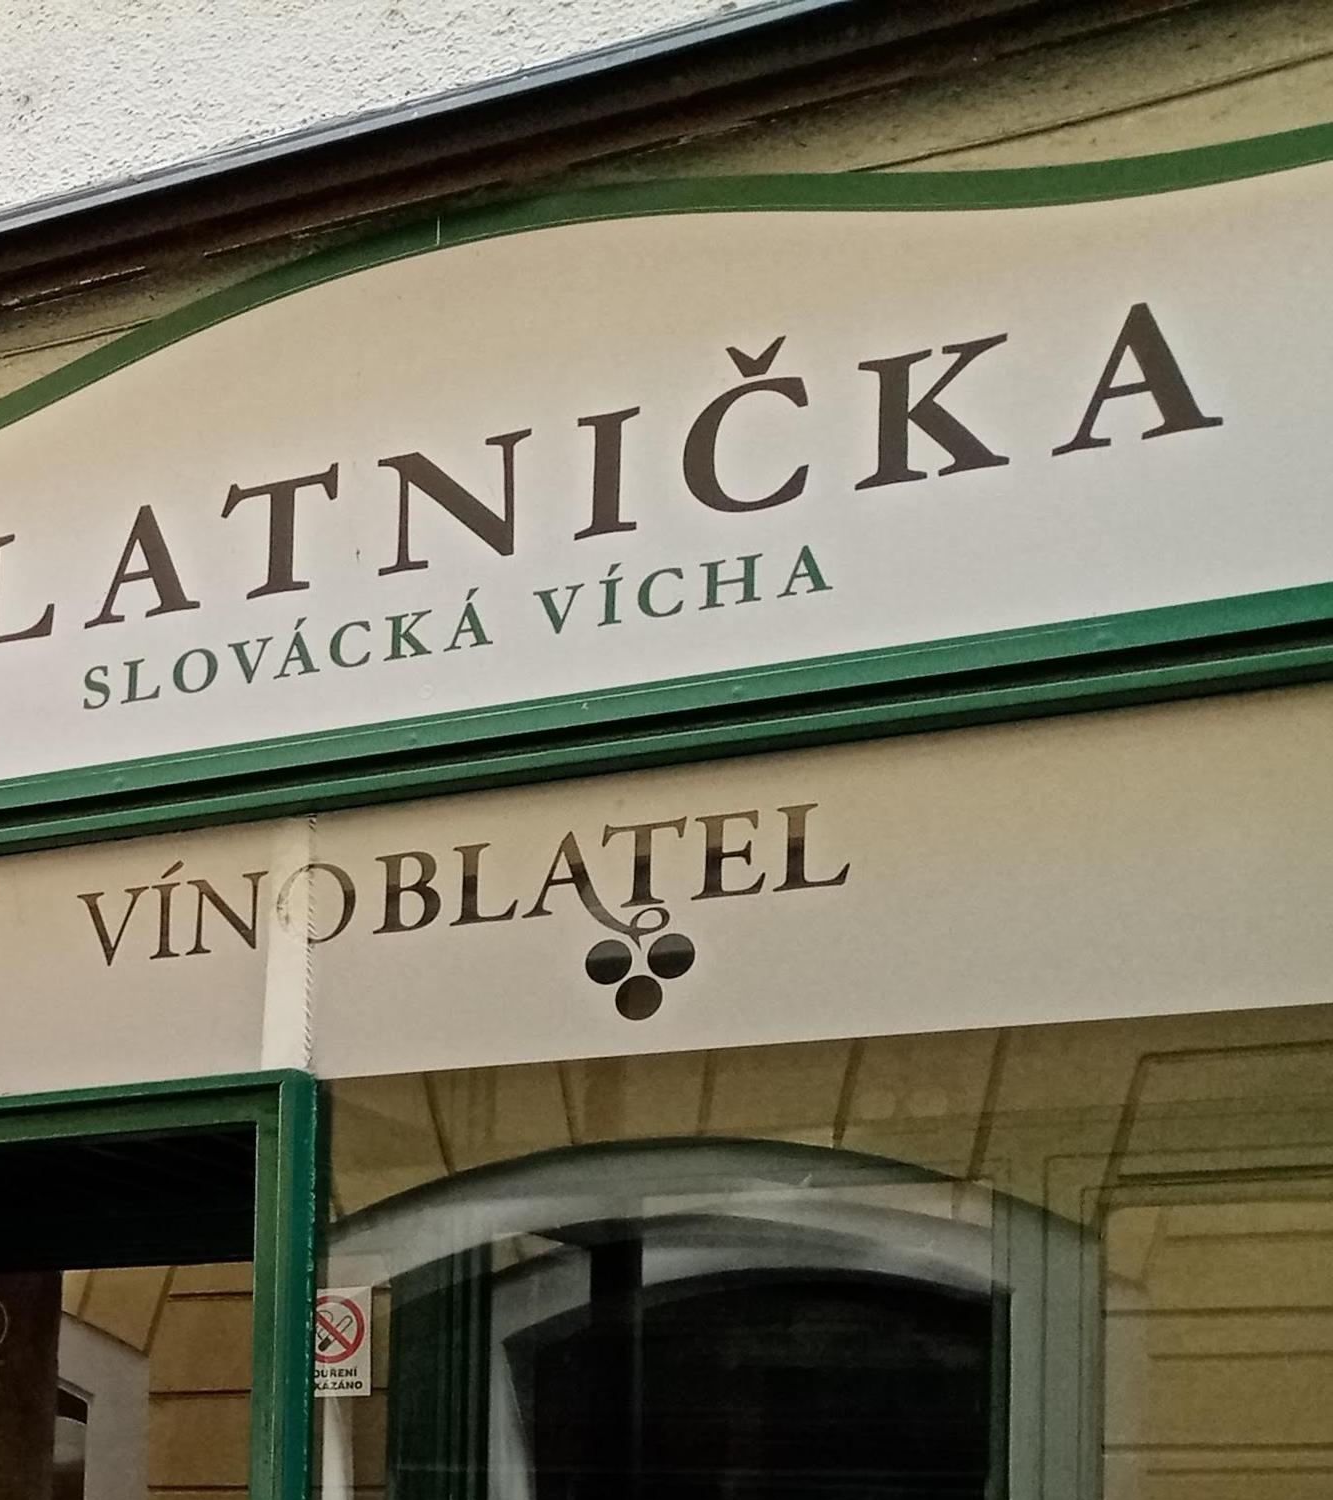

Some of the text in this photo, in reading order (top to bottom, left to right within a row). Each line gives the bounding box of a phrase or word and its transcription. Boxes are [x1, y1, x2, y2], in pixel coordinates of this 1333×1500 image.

[83, 545, 833, 710] SLOVÁCKÁ VÍCHA
[79, 802, 849, 968] VÍNOBLATEL
[315, 1367, 358, 1378] OUŘENÍ
